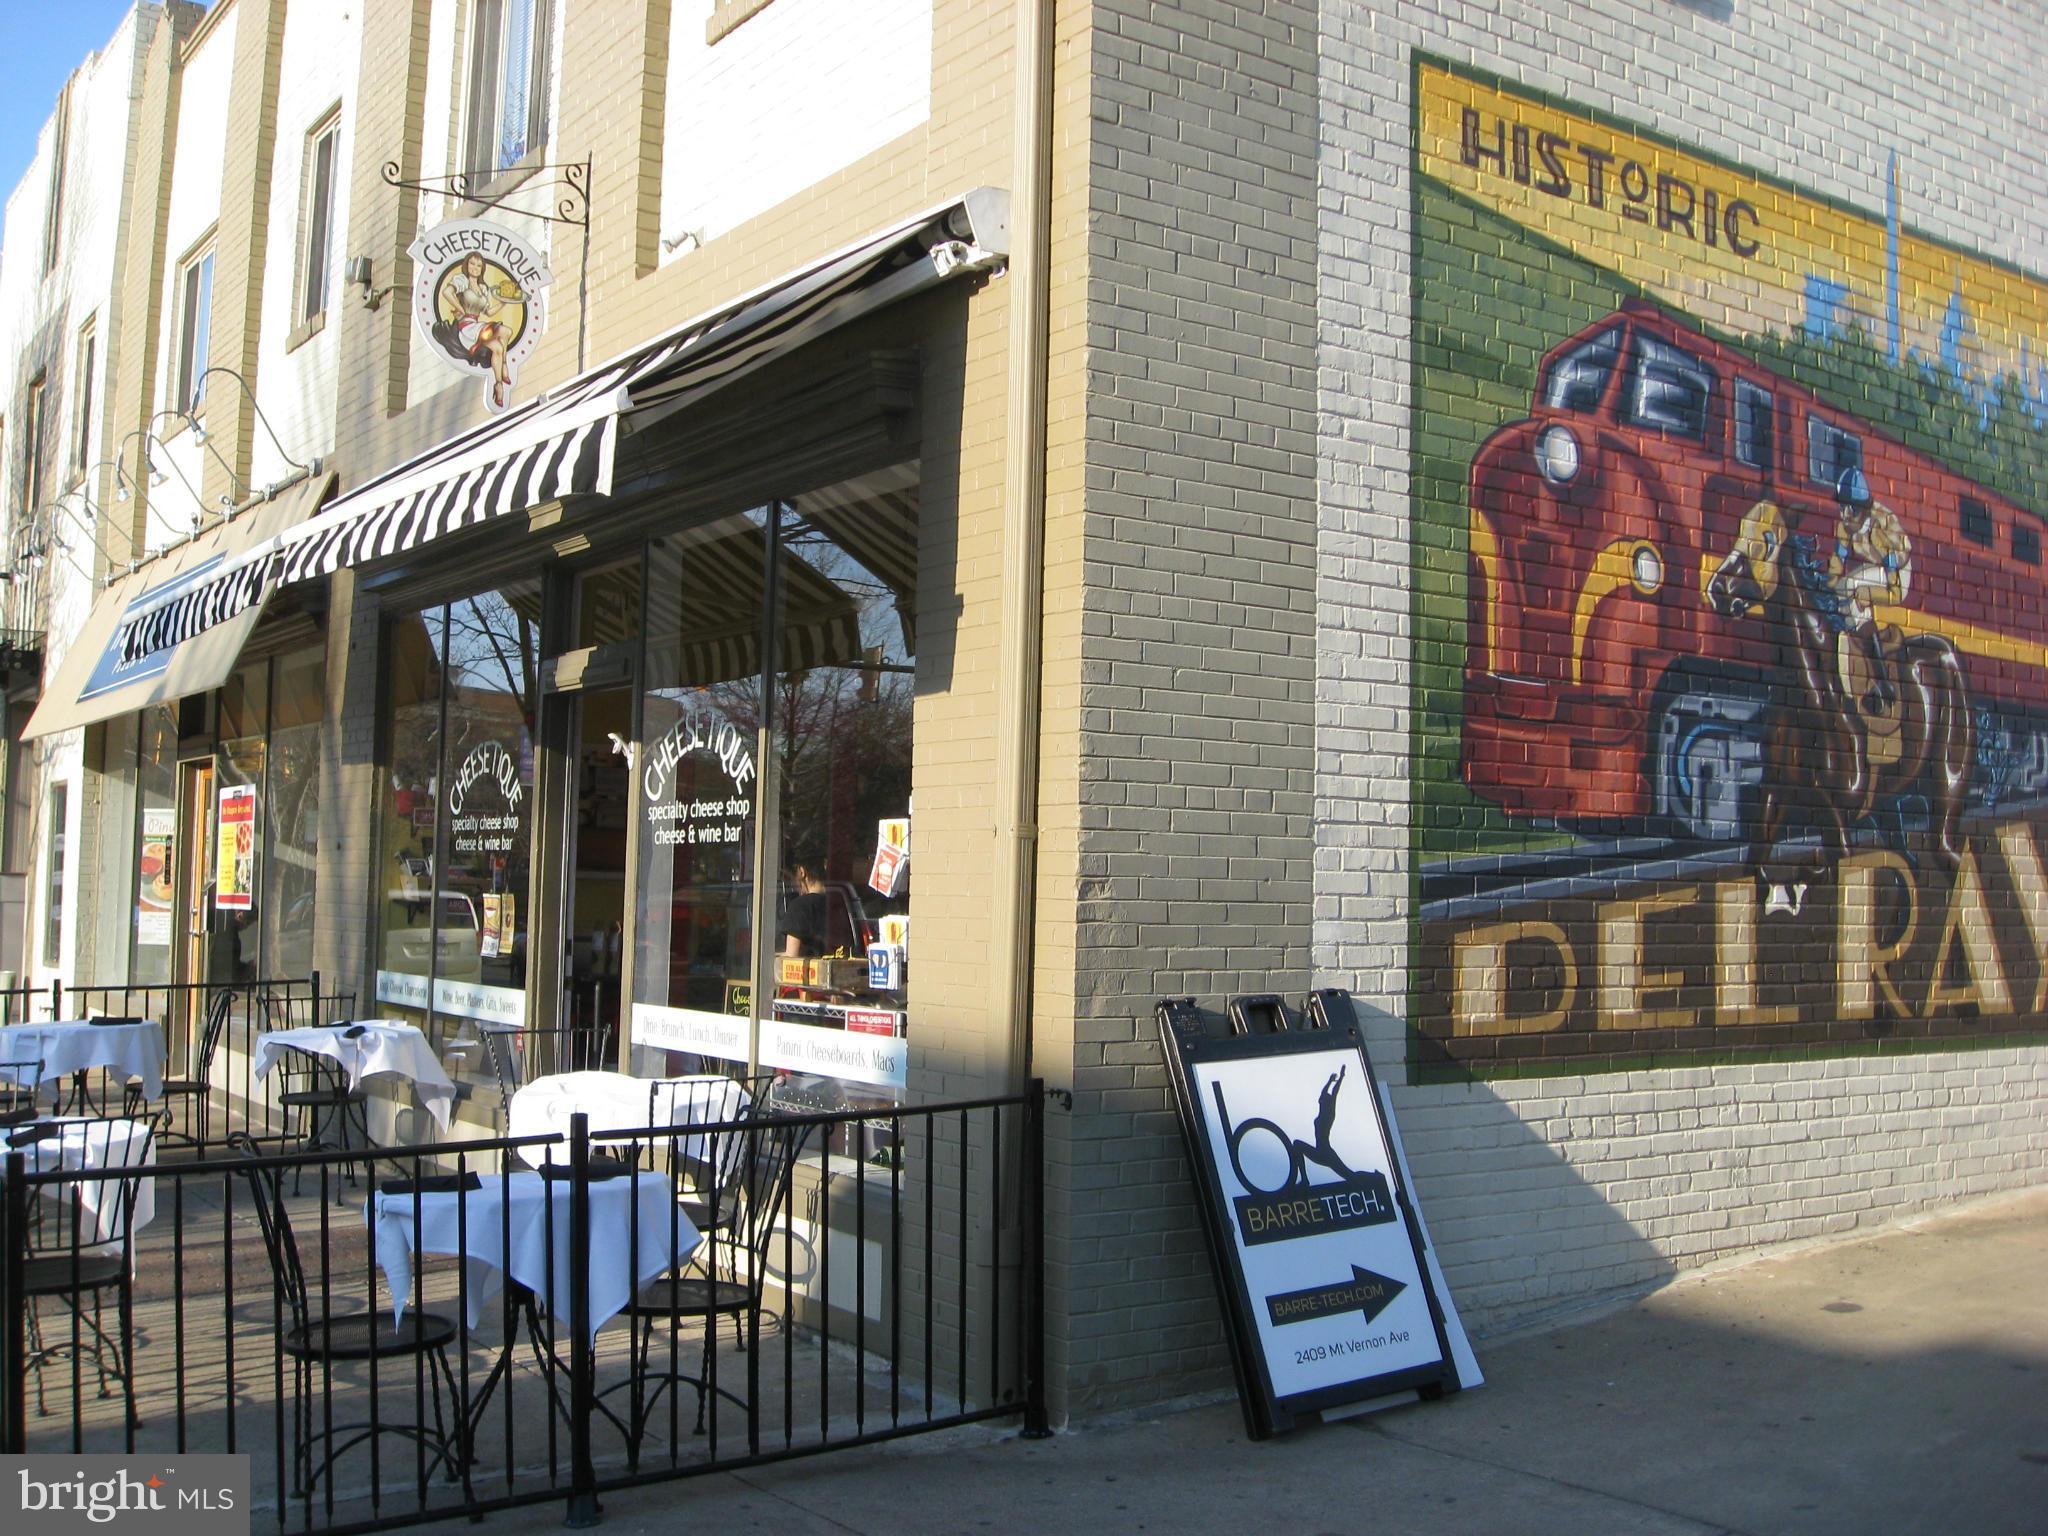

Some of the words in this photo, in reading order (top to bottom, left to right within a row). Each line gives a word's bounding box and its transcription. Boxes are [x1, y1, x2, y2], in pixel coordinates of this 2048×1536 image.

[1461, 105, 1761, 258] HISTORIC
[423, 229, 541, 285] CHEESETIQUE
[644, 706, 756, 801] CHEESETIQUE
[450, 740, 523, 815] CHEESETIQUE
[452, 816, 479, 835] specialty
[480, 814, 502, 831] cheese
[503, 813, 519, 833] shop
[648, 801, 688, 824] specialty
[690, 798, 723, 818] cheese
[726, 795, 750, 820] shop
[455, 835, 477, 851] cheese
[478, 835, 483, 851] &
[485, 835, 501, 851] wine
[502, 834, 514, 851] bar
[654, 826, 685, 845] cheese
[688, 824, 696, 843] &
[698, 824, 722, 843] wine
[724, 822, 741, 842] bar
[1453, 876, 1799, 1037] DEL
[714, 1025, 738, 1047] Dinner
[872, 1048, 895, 1072] Macs
[1274, 1283, 1384, 1317] BARRE-TECH.COM
[1294, 1346, 1327, 1365] 2409
[1328, 1343, 1344, 1358] Mt
[1345, 1336, 1387, 1353] Vernon
[1389, 1330, 1410, 1346] Ave
